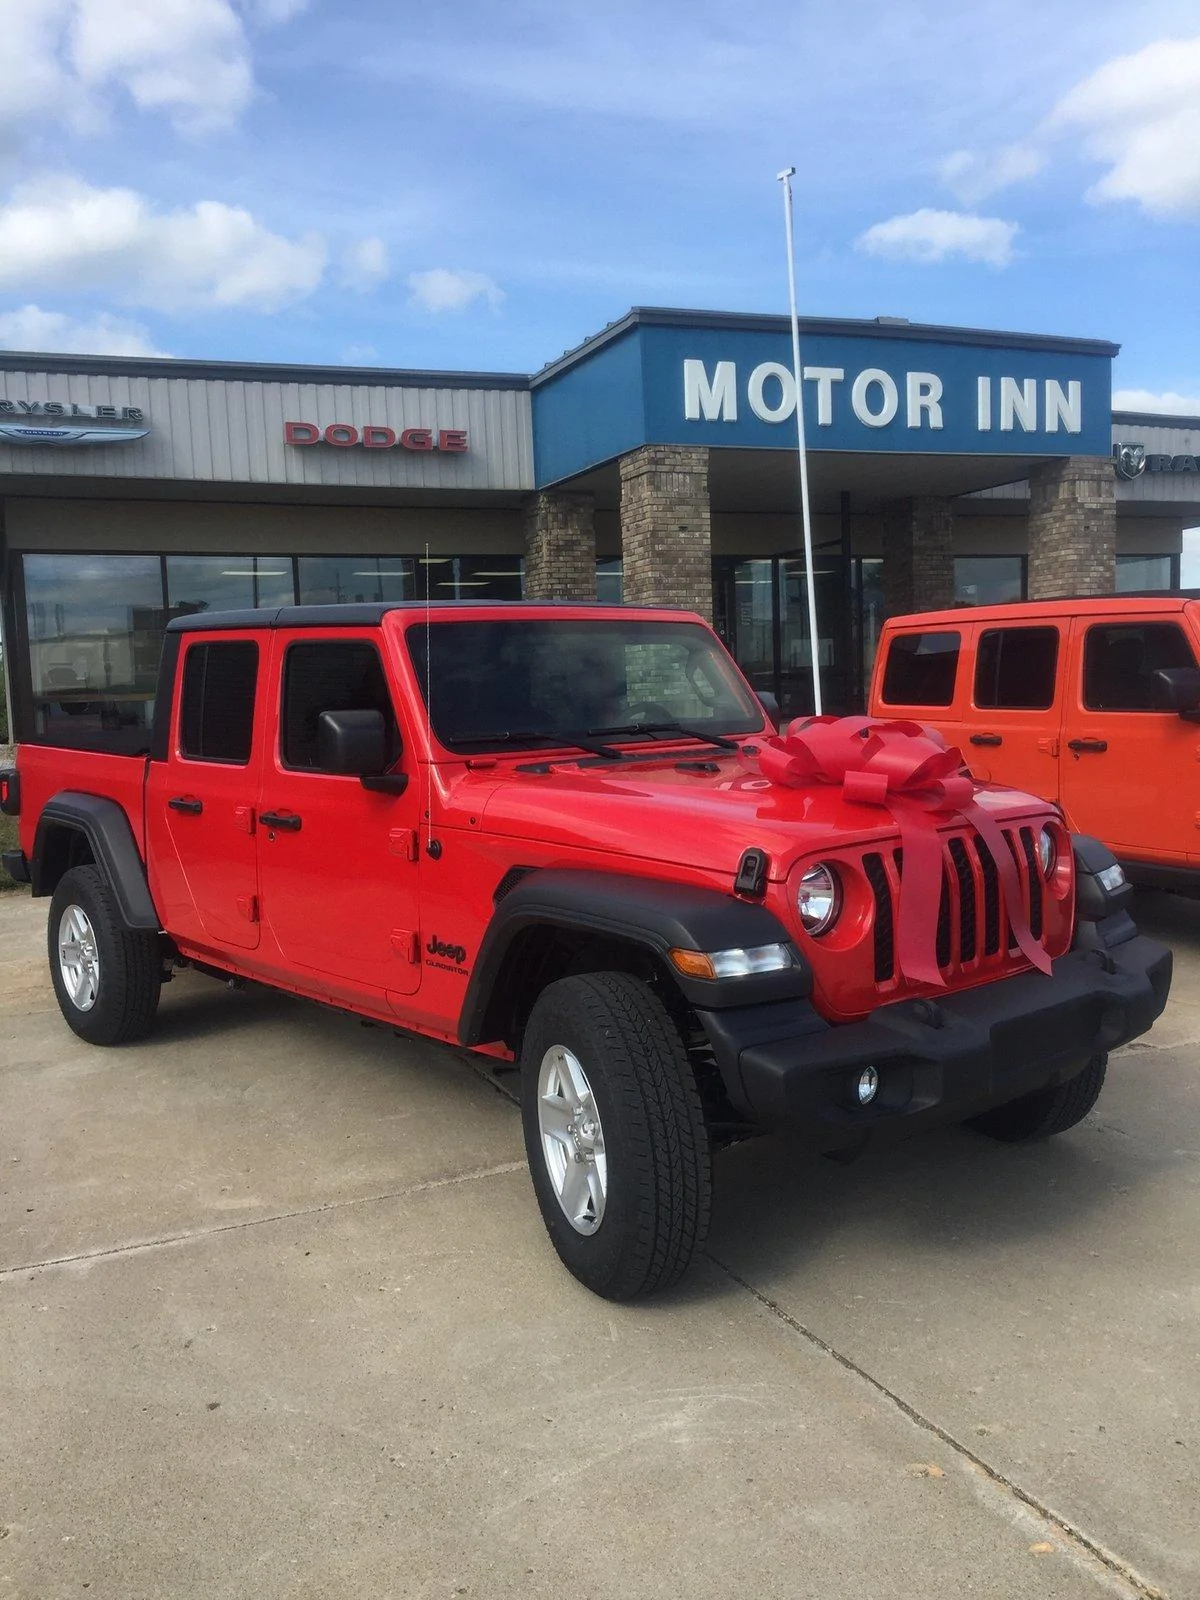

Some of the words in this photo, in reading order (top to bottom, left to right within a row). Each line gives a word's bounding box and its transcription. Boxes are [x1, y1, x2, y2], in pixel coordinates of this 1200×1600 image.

[684, 359, 943, 428] MOTOR
[977, 376, 1081, 433] INN
[284, 421, 469, 451] DODGE
[426, 934, 466, 964] Jeep
[426, 959, 469, 976] GLADIATOR
